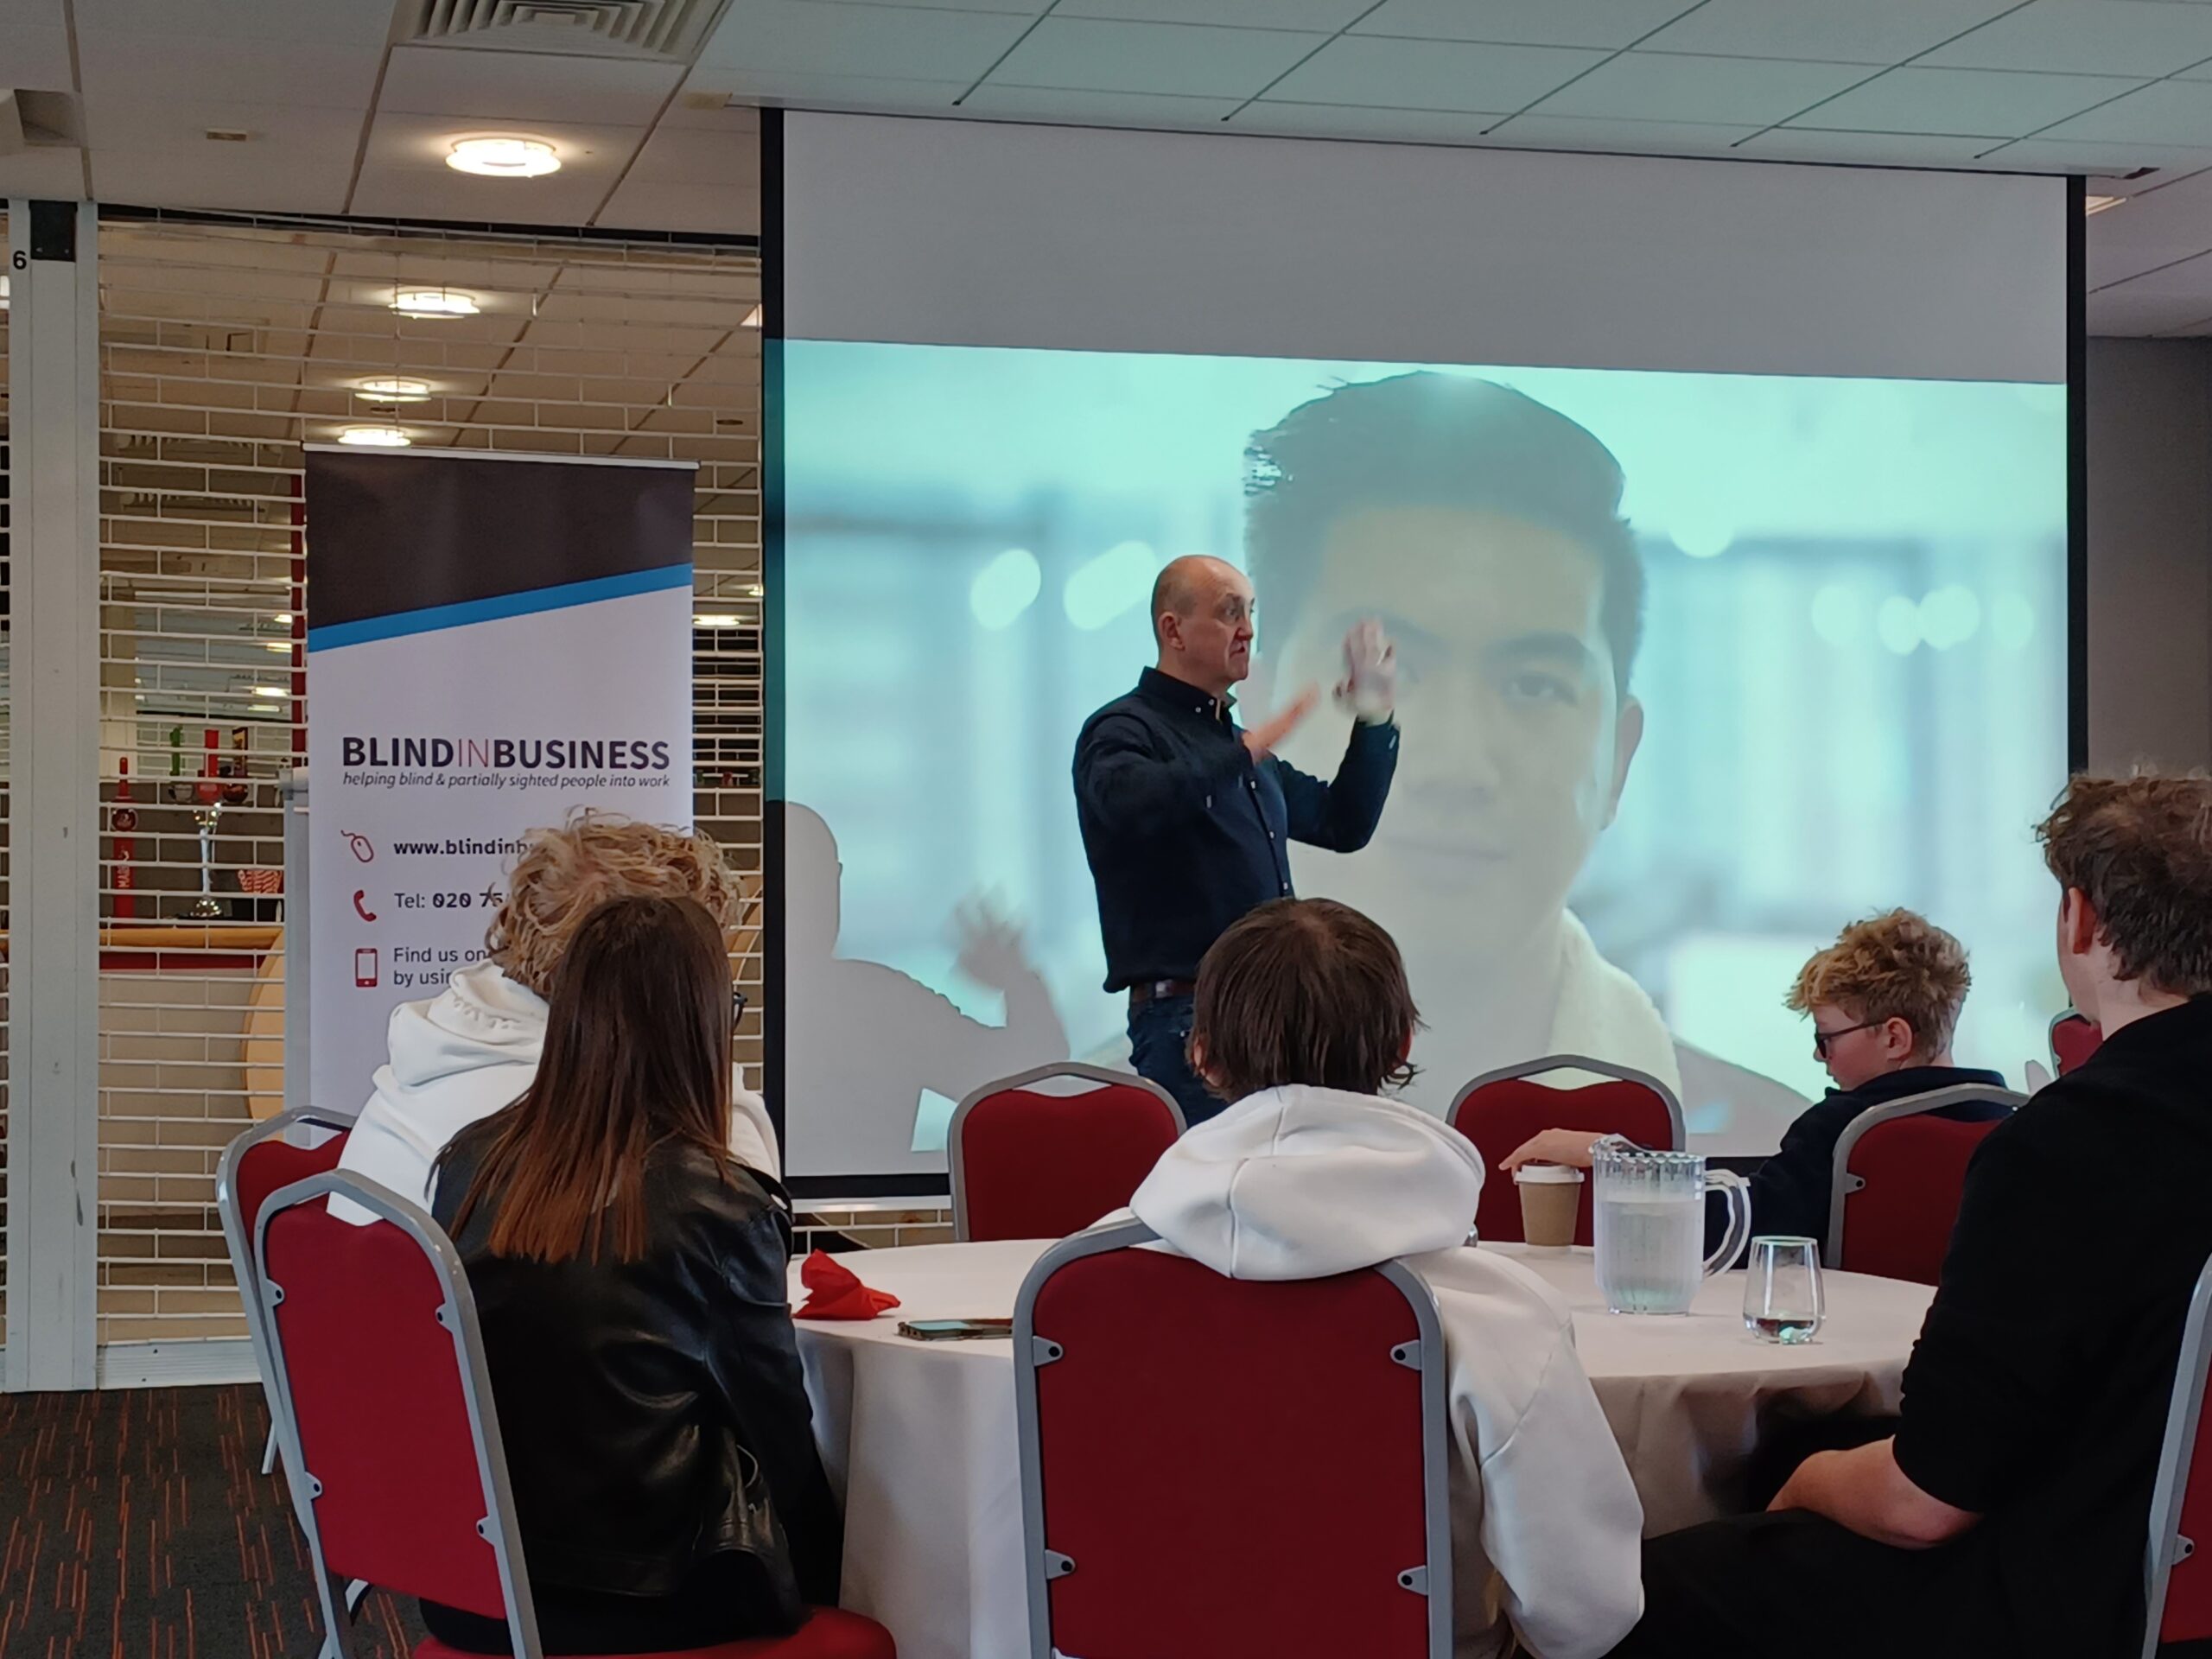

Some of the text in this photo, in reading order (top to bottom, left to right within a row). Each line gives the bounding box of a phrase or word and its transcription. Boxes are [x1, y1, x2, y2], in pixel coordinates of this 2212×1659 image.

[13, 251, 27, 270] 6
[343, 772, 670, 790] helping blind & partially sighted people into work
[394, 838, 532, 855] www.blindinb
[394, 893, 510, 908] Tel: 020 75
[394, 947, 486, 963] Find us on
[394, 969, 413, 988] by
